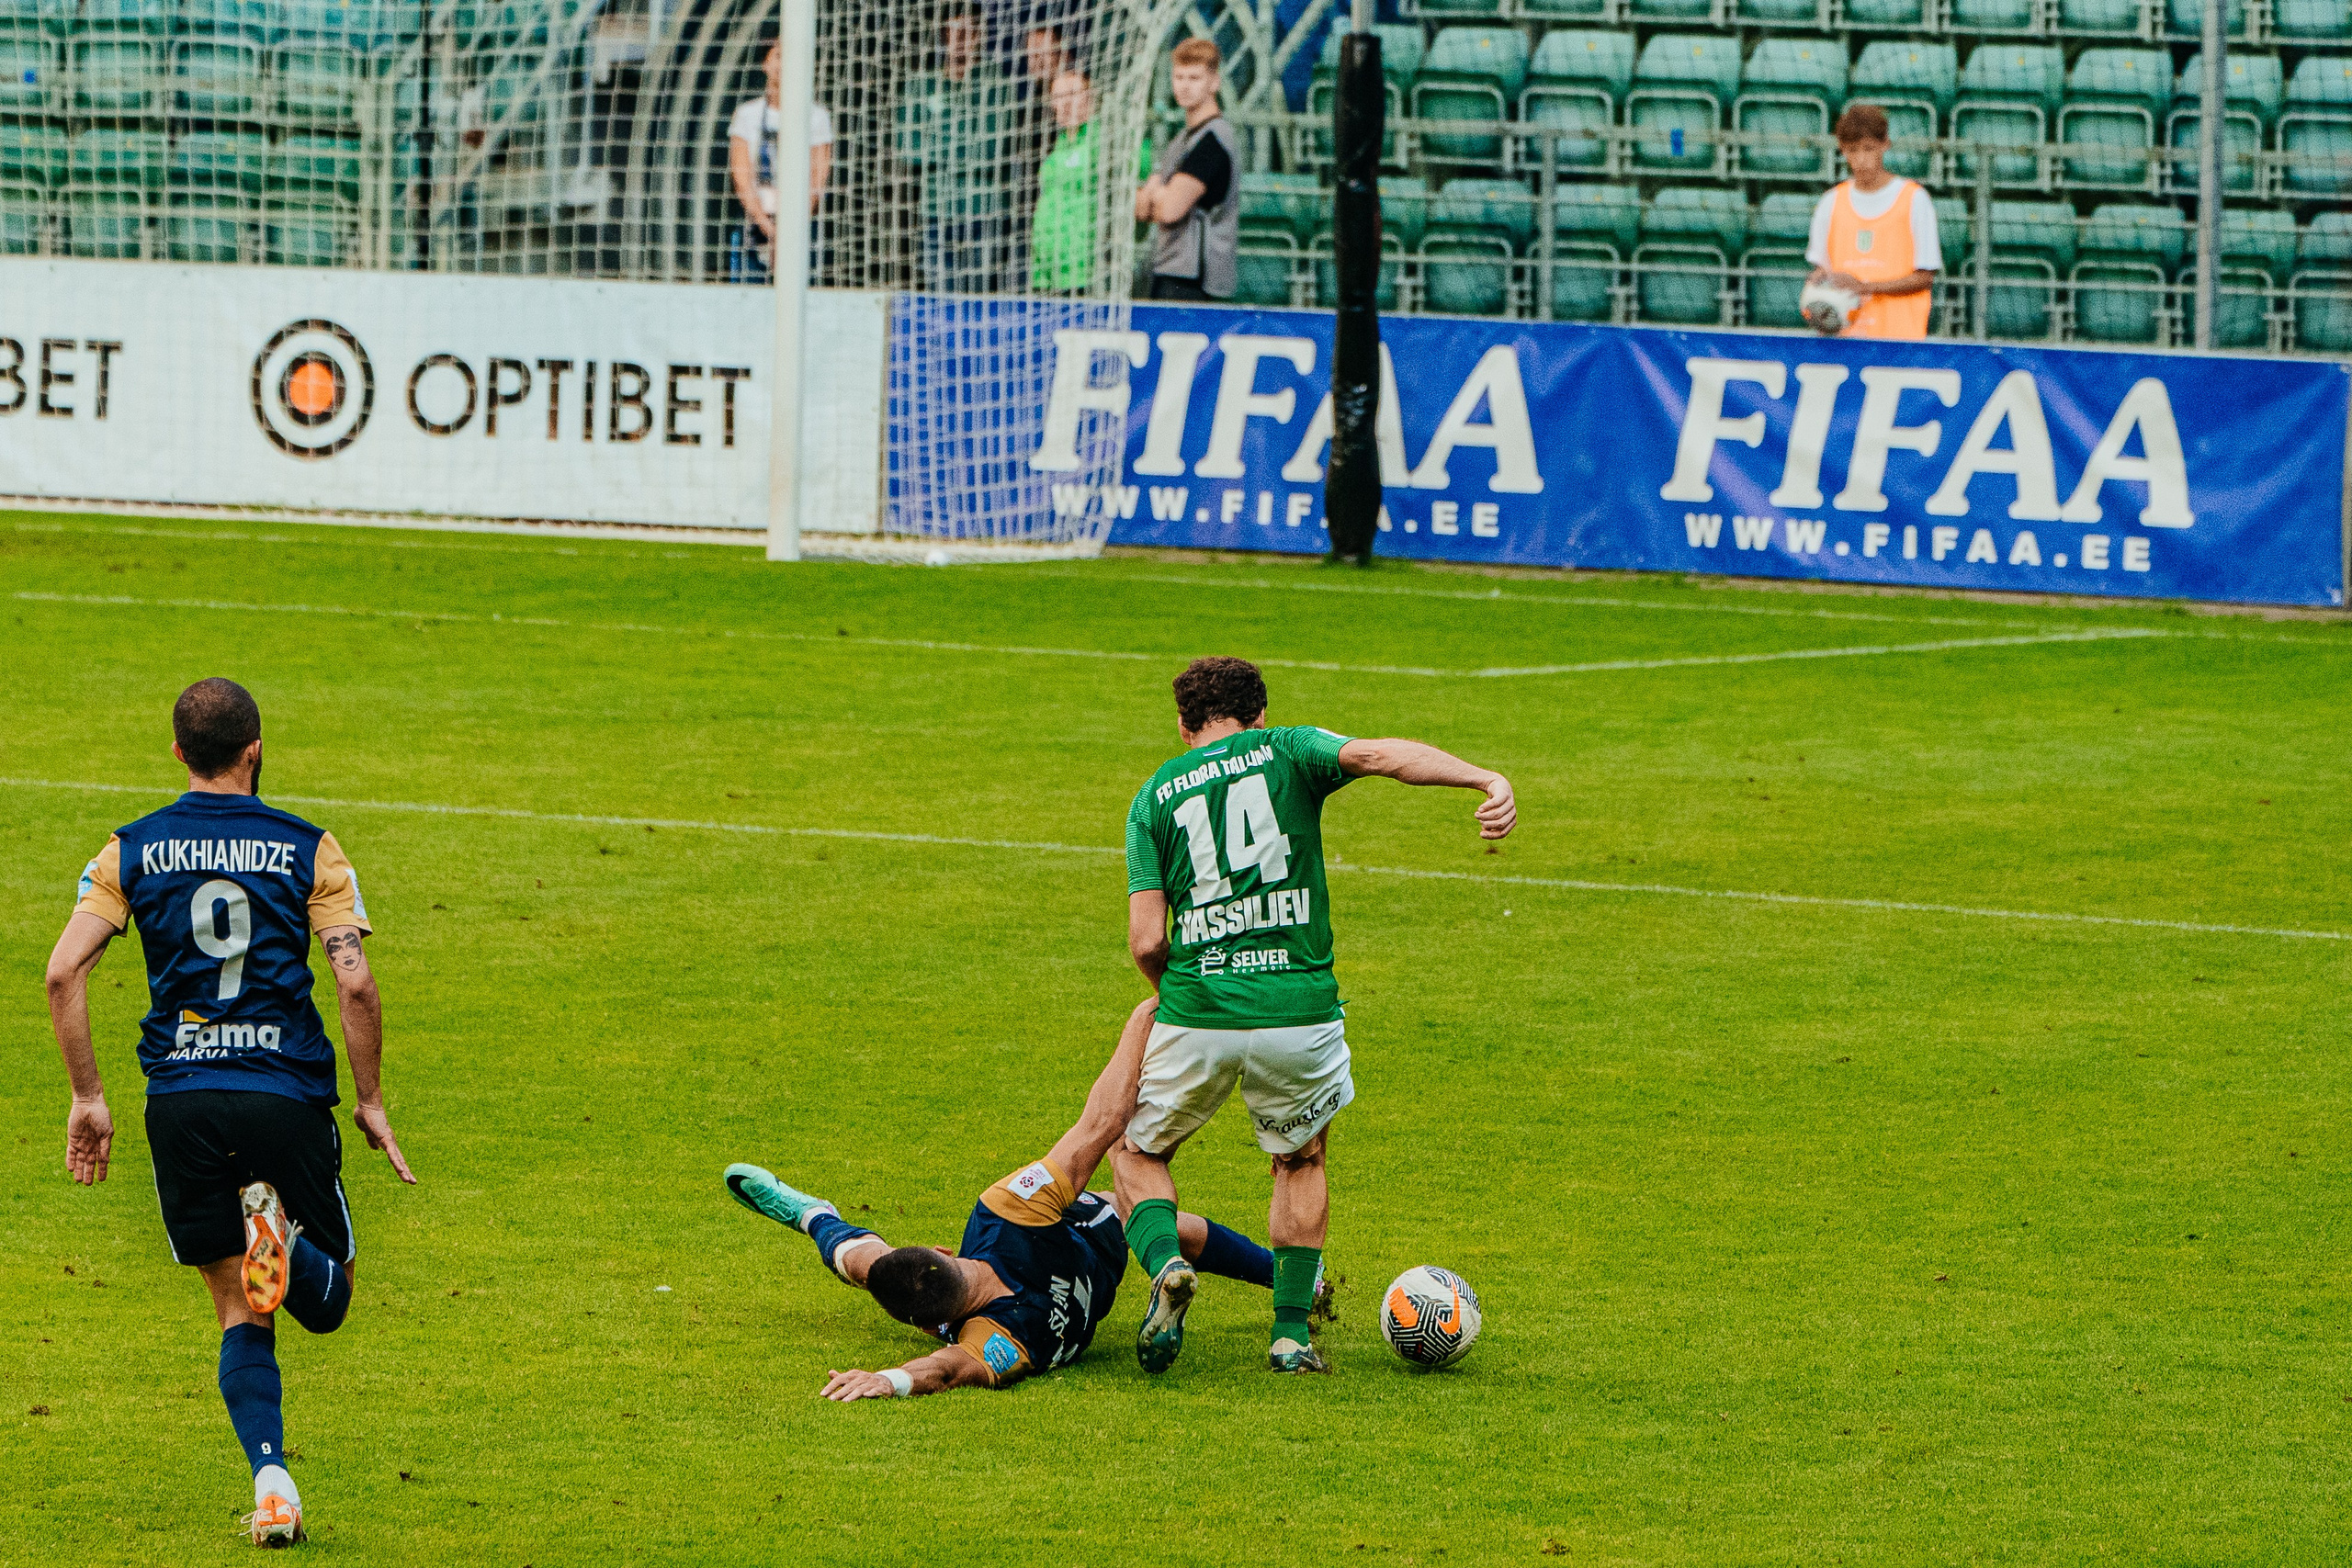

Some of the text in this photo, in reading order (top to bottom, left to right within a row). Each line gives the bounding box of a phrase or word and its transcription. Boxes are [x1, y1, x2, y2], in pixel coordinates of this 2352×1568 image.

[405, 353, 752, 448] OPTIBET
[1659, 356, 2196, 529] FIFAA
[1685, 513, 2151, 572] WWW.FIFAA.EE
[1156, 781, 1174, 806] FC
[1173, 761, 1222, 795] FLORA
[142, 838, 296, 876] KUKHIANIDZE
[1172, 773, 1292, 908] 14
[190, 878, 252, 1001] 9
[1177, 887, 1310, 946] VASSILJEV
[1231, 948, 1290, 968] SELVER
[175, 1022, 282, 1051] Fama
[261, 1441, 272, 1455] 9
